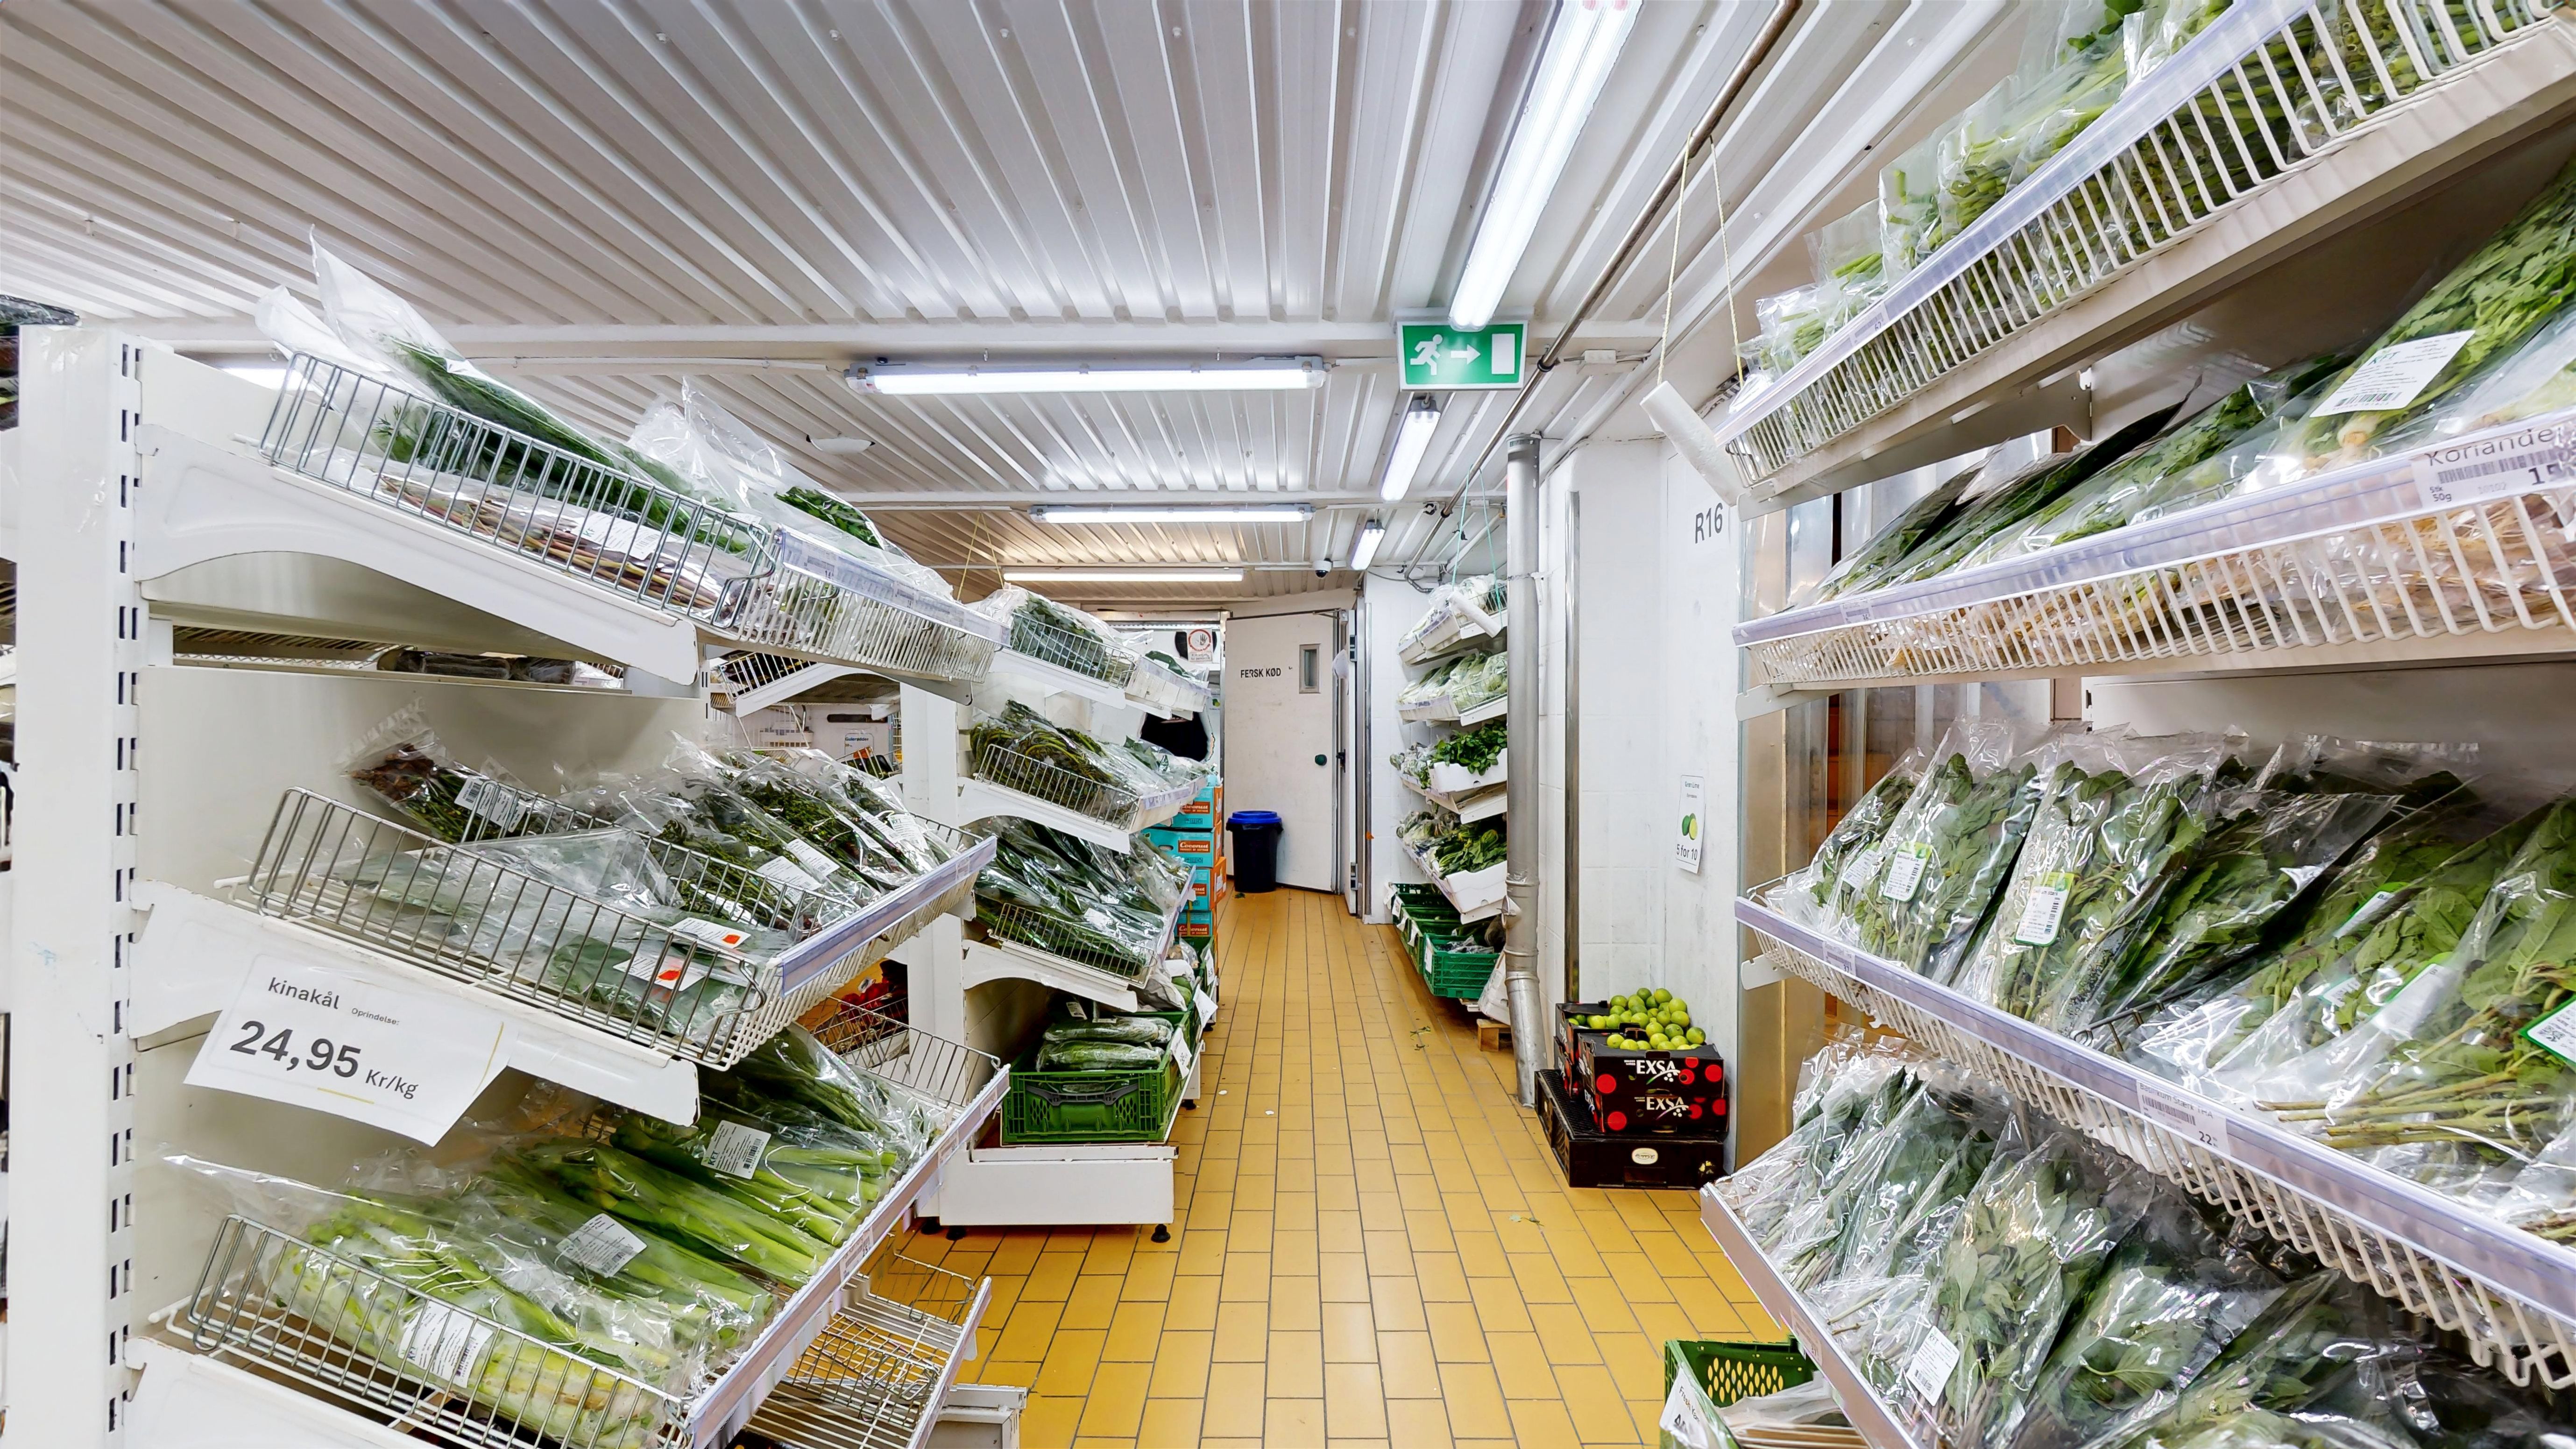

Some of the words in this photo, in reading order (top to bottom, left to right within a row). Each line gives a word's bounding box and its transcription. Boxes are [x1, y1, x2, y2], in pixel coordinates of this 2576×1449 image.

[2433, 493, 2452, 502] 50g
[1695, 502, 1723, 544] R16
[1240, 668, 1263, 678] FERSK
[1266, 668, 1281, 677] KØD
[1677, 843, 1680, 855] 5
[1681, 845, 1690, 858] for
[1691, 848, 1698, 861] 10
[268, 977, 340, 1010] kinakål
[351, 1007, 400, 1025] Oprindelse:
[229, 1020, 361, 1078] 24,95
[365, 1069, 419, 1100] Kr/kg
[1636, 1060, 1679, 1076] EXSA
[1646, 1096, 1687, 1110] EXSA
[2199, 1131, 2213, 1145] 22
[708, 1151, 719, 1166] KFT
